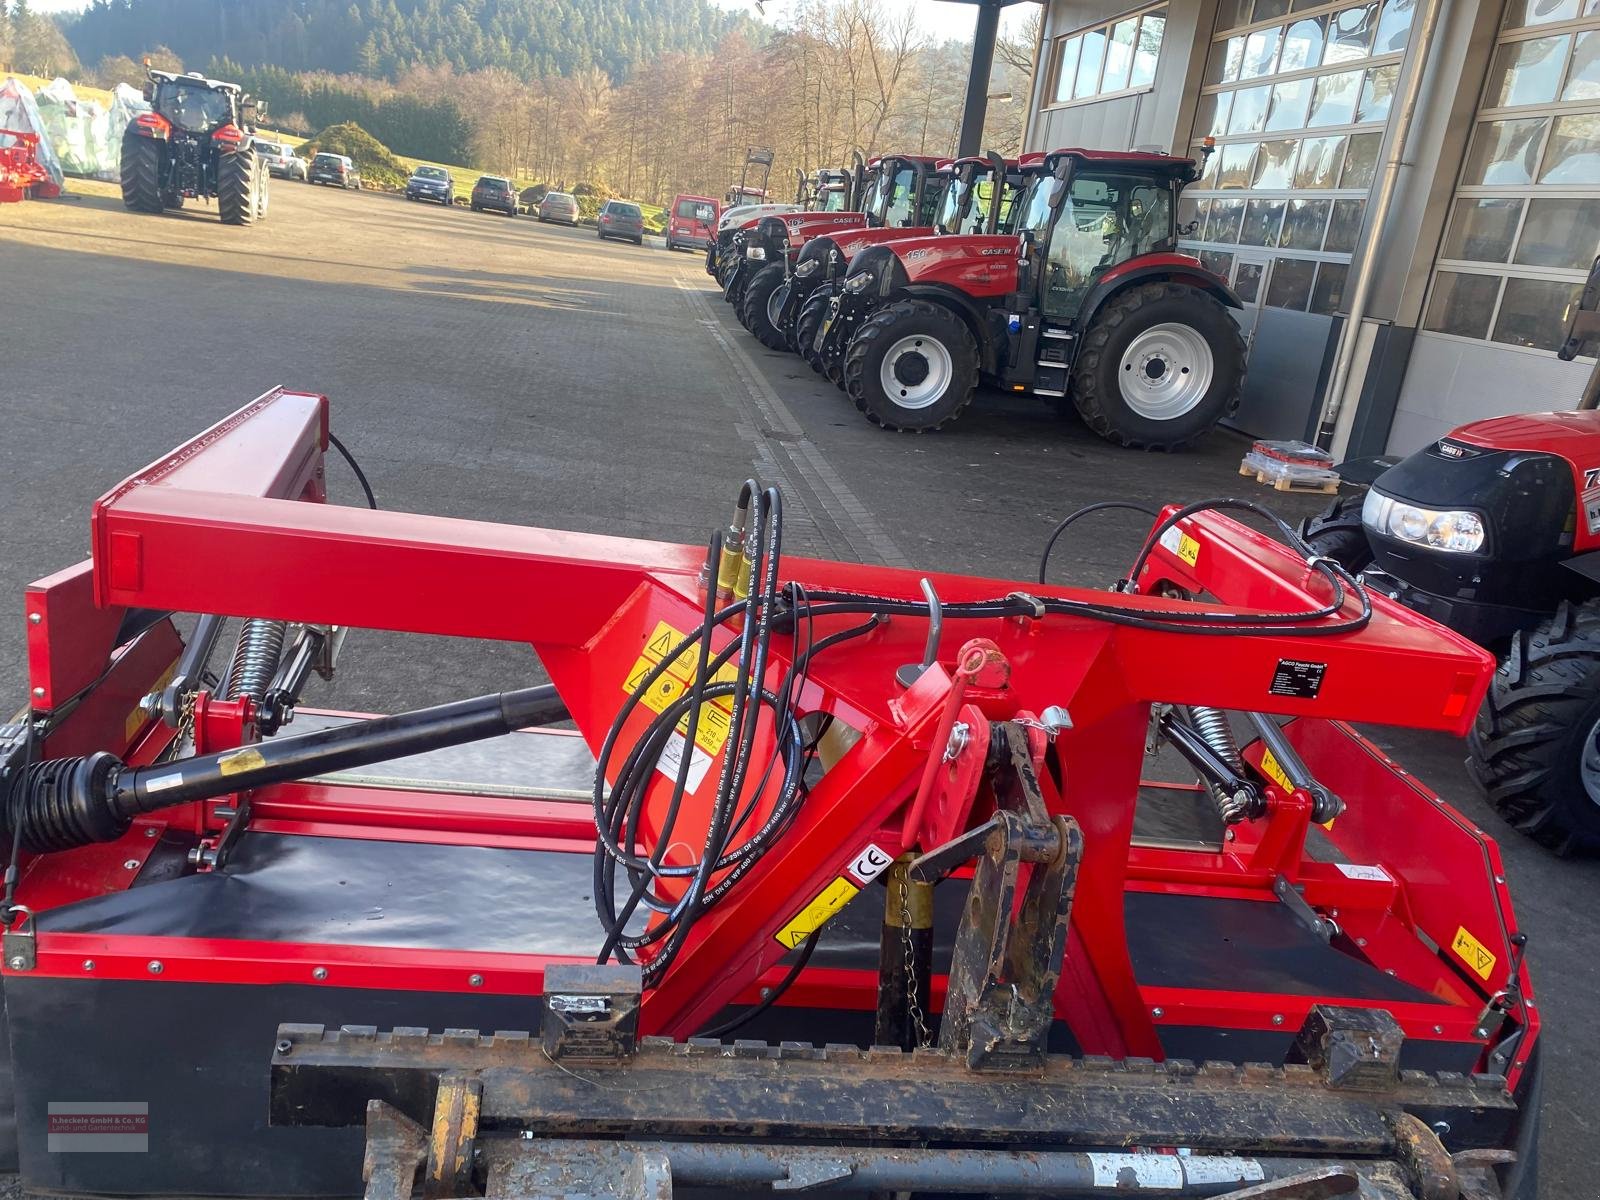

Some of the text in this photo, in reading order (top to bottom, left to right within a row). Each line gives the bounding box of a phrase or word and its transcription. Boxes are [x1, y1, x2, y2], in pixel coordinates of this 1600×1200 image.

[907, 250, 928, 261] 150
[762, 824, 771, 835] WP
[772, 813, 780, 824] 400
[779, 802, 787, 812] bar
[858, 850, 888, 876] CE
[732, 870, 740, 879] WP
